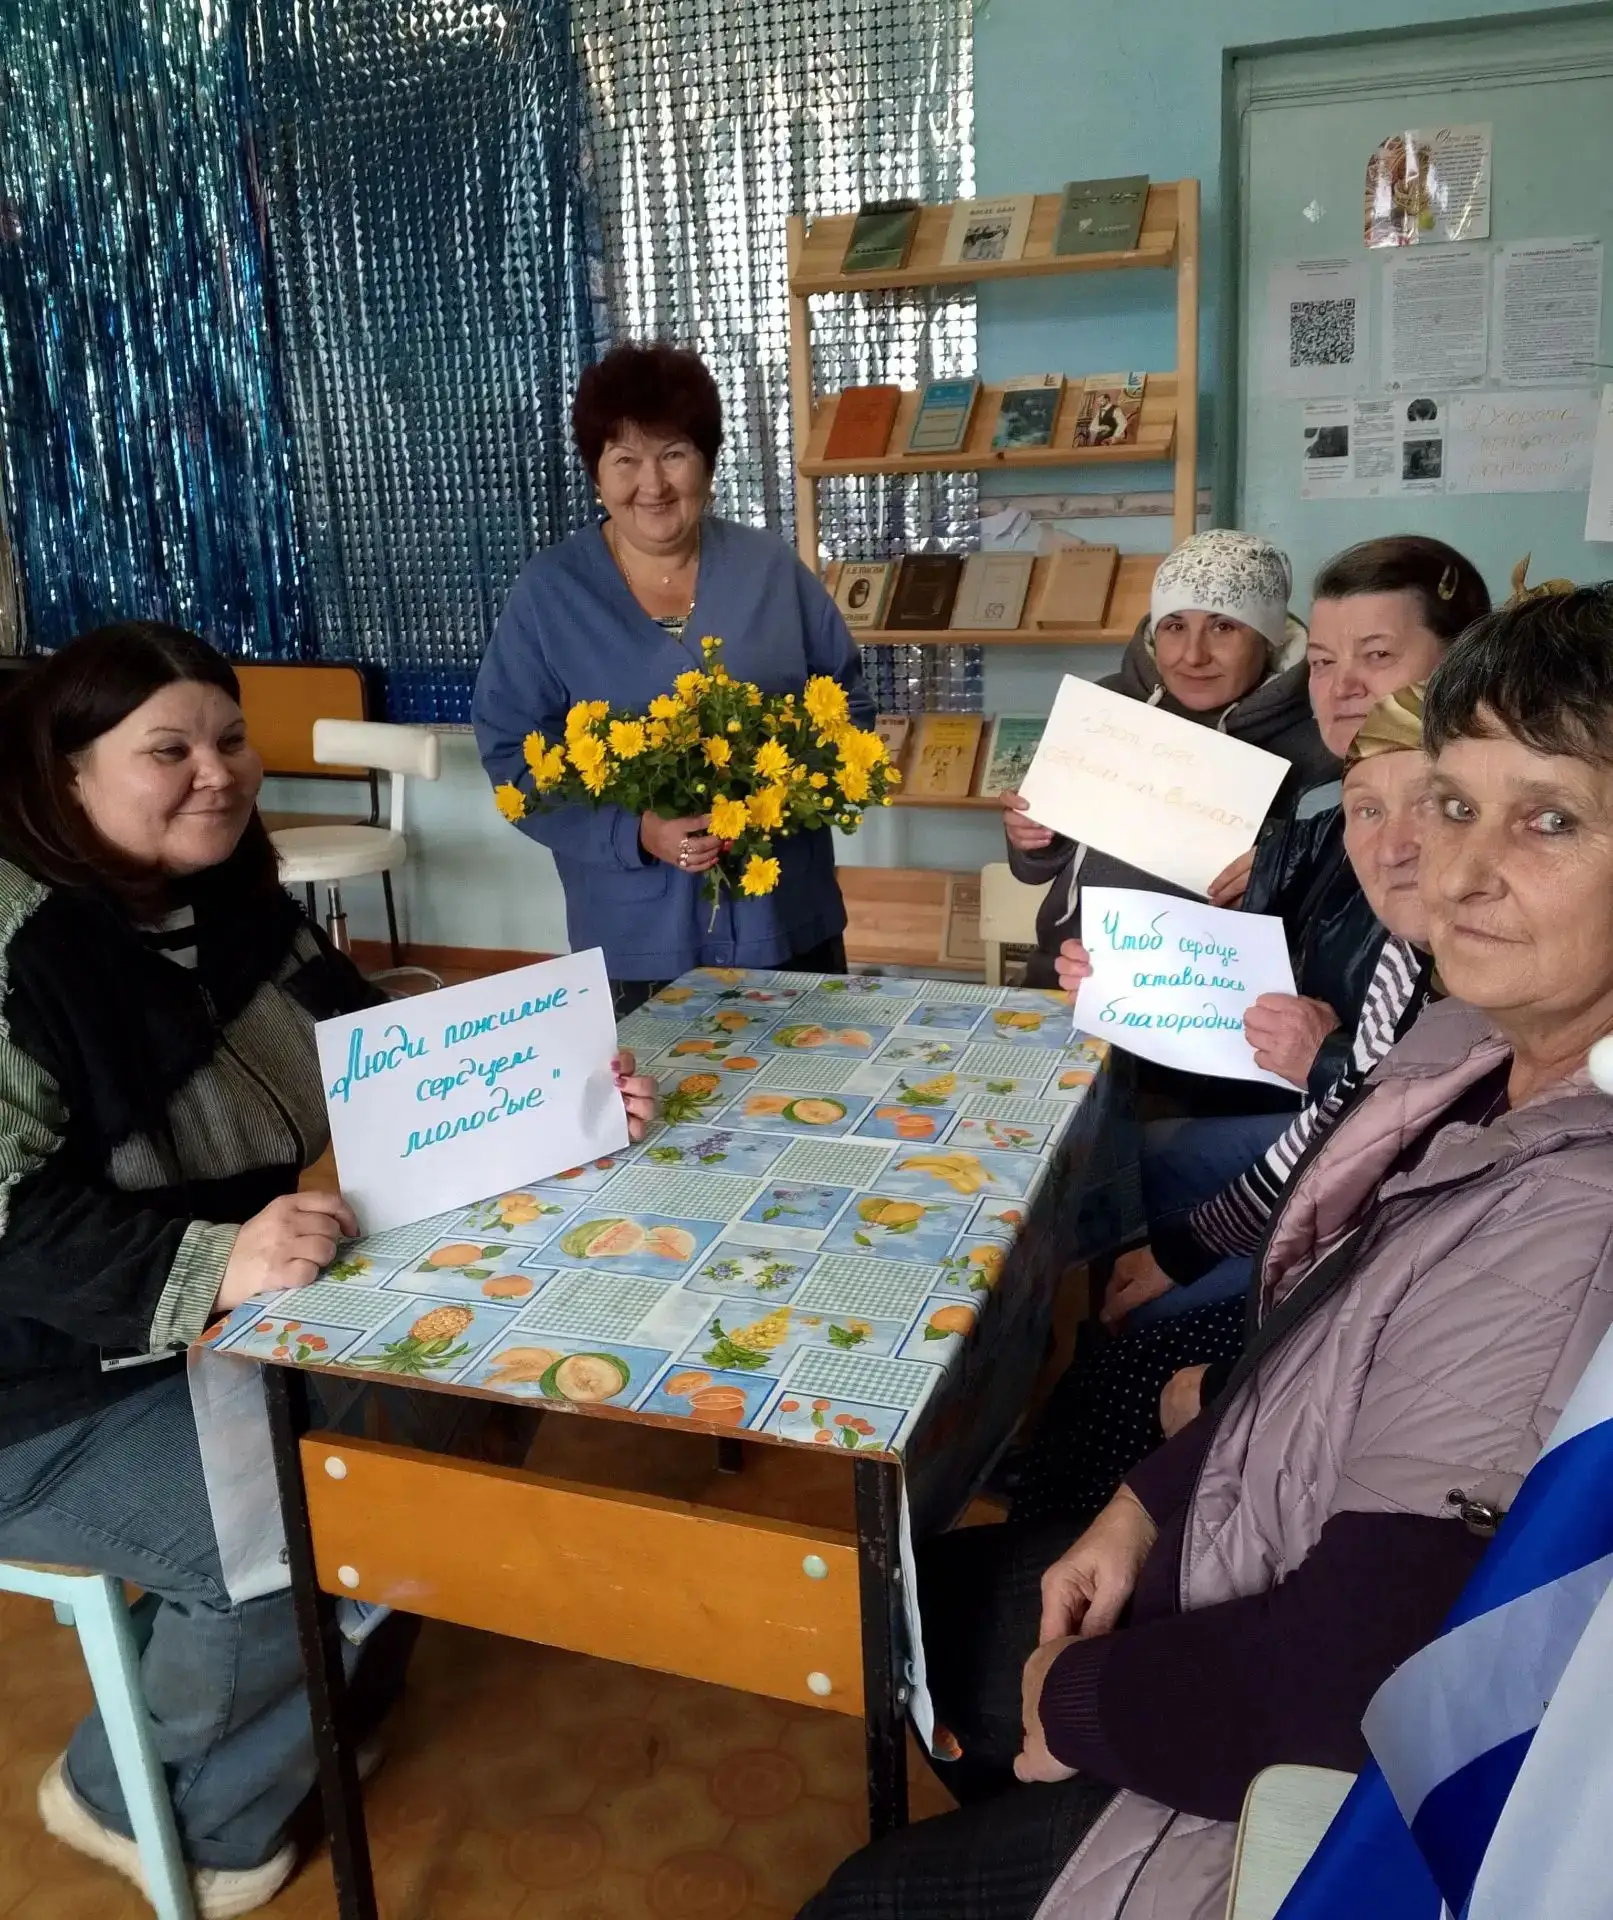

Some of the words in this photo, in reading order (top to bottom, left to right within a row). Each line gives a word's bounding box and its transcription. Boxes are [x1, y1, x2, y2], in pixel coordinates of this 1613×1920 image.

[1101, 909, 1170, 951] Чтоб
[1179, 932, 1240, 967] сердце
[1133, 966, 1245, 991] оставалось
[444, 987, 568, 1048] пожилые
[1099, 996, 1243, 1034] благородны
[416, 1046, 539, 1101] сердцем
